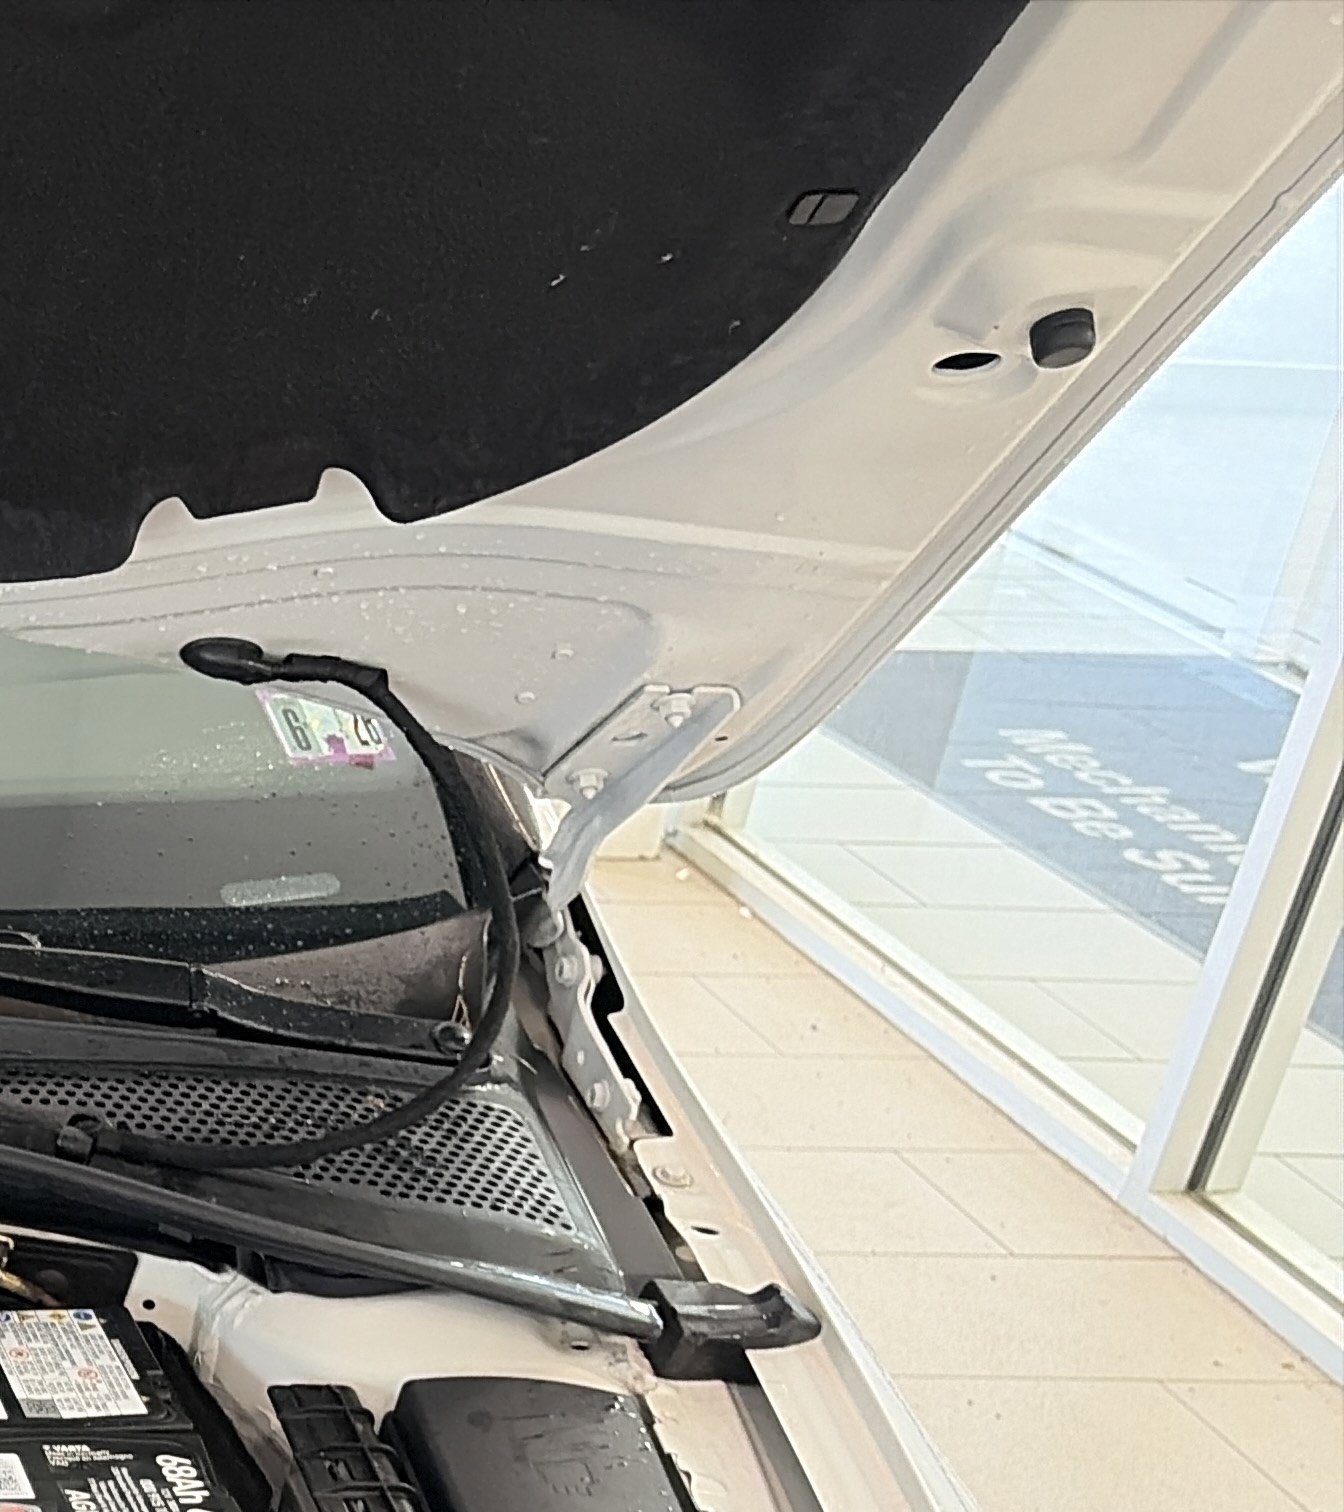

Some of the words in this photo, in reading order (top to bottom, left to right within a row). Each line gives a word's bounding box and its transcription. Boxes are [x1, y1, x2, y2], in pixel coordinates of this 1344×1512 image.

[282, 709, 312, 751] 6
[1026, 796, 1134, 841] Be
[156, 1454, 210, 1505] 68Ah
